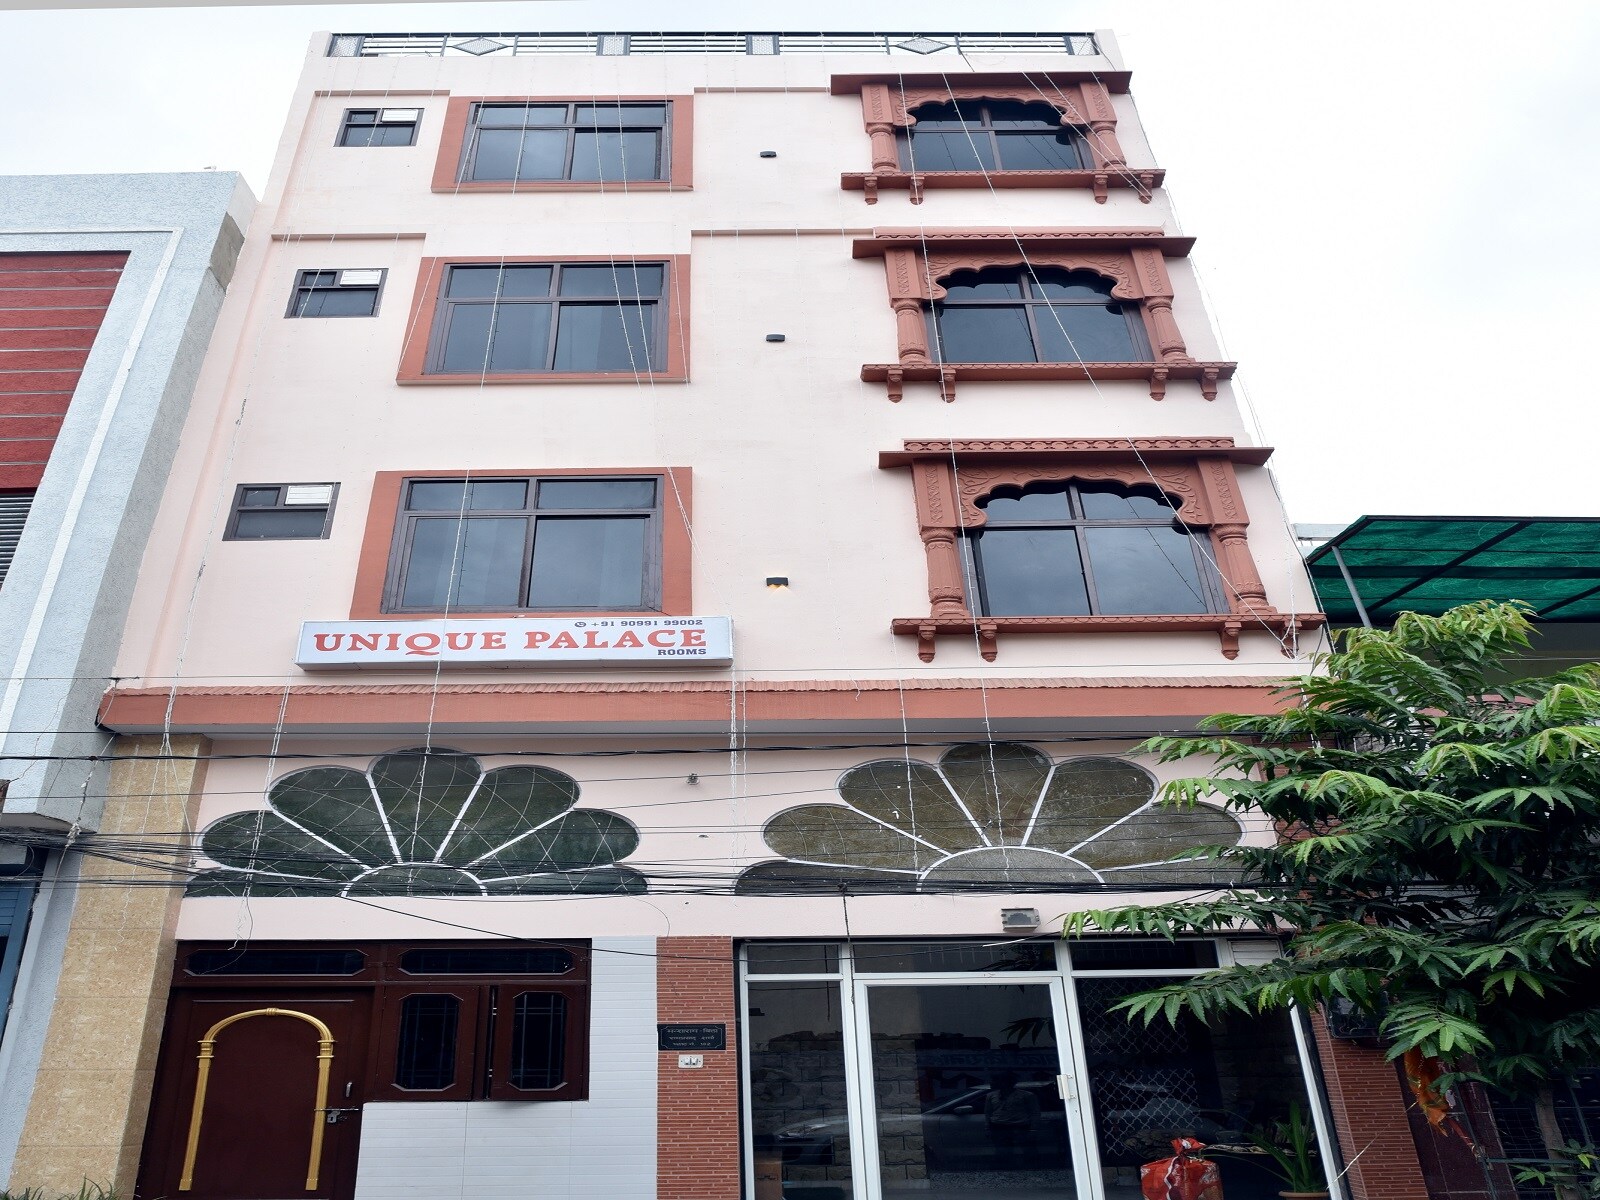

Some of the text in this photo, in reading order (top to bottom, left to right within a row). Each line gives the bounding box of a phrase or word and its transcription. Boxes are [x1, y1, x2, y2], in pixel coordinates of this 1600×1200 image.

[313, 629, 707, 656] UNIQUE PALACE
[657, 648, 707, 656] ROOMS
